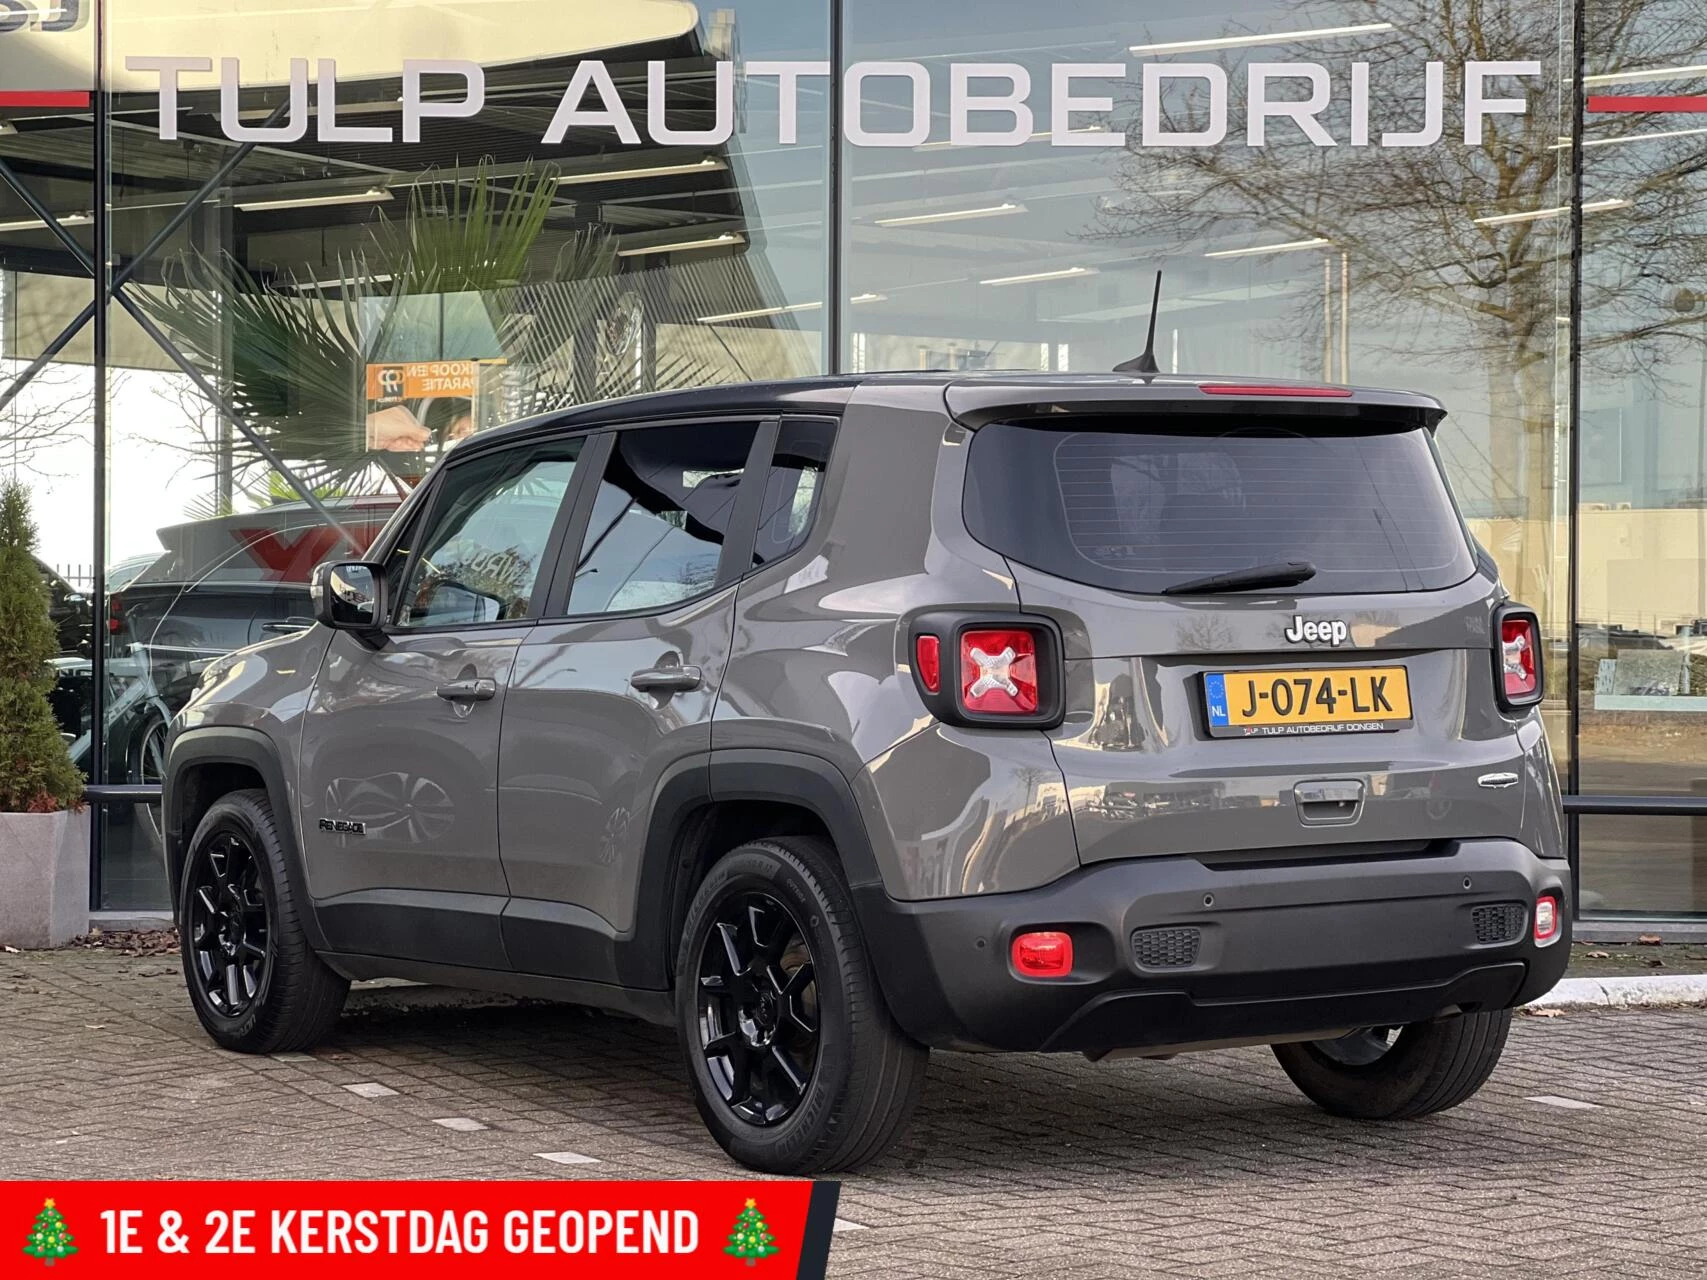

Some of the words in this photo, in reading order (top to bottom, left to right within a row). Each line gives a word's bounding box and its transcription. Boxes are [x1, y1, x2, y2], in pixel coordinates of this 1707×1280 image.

[125, 55, 485, 144] TULP
[541, 59, 1541, 148] AUTOBEDRIJF
[1285, 615, 1348, 647] Jeep
[1211, 705, 1227, 717] NL
[1241, 675, 1393, 718] J-074-LK
[1262, 726, 1285, 735] TULP
[1286, 723, 1345, 734] AUTOBEDRIJF
[1346, 722, 1384, 731] DONGEN
